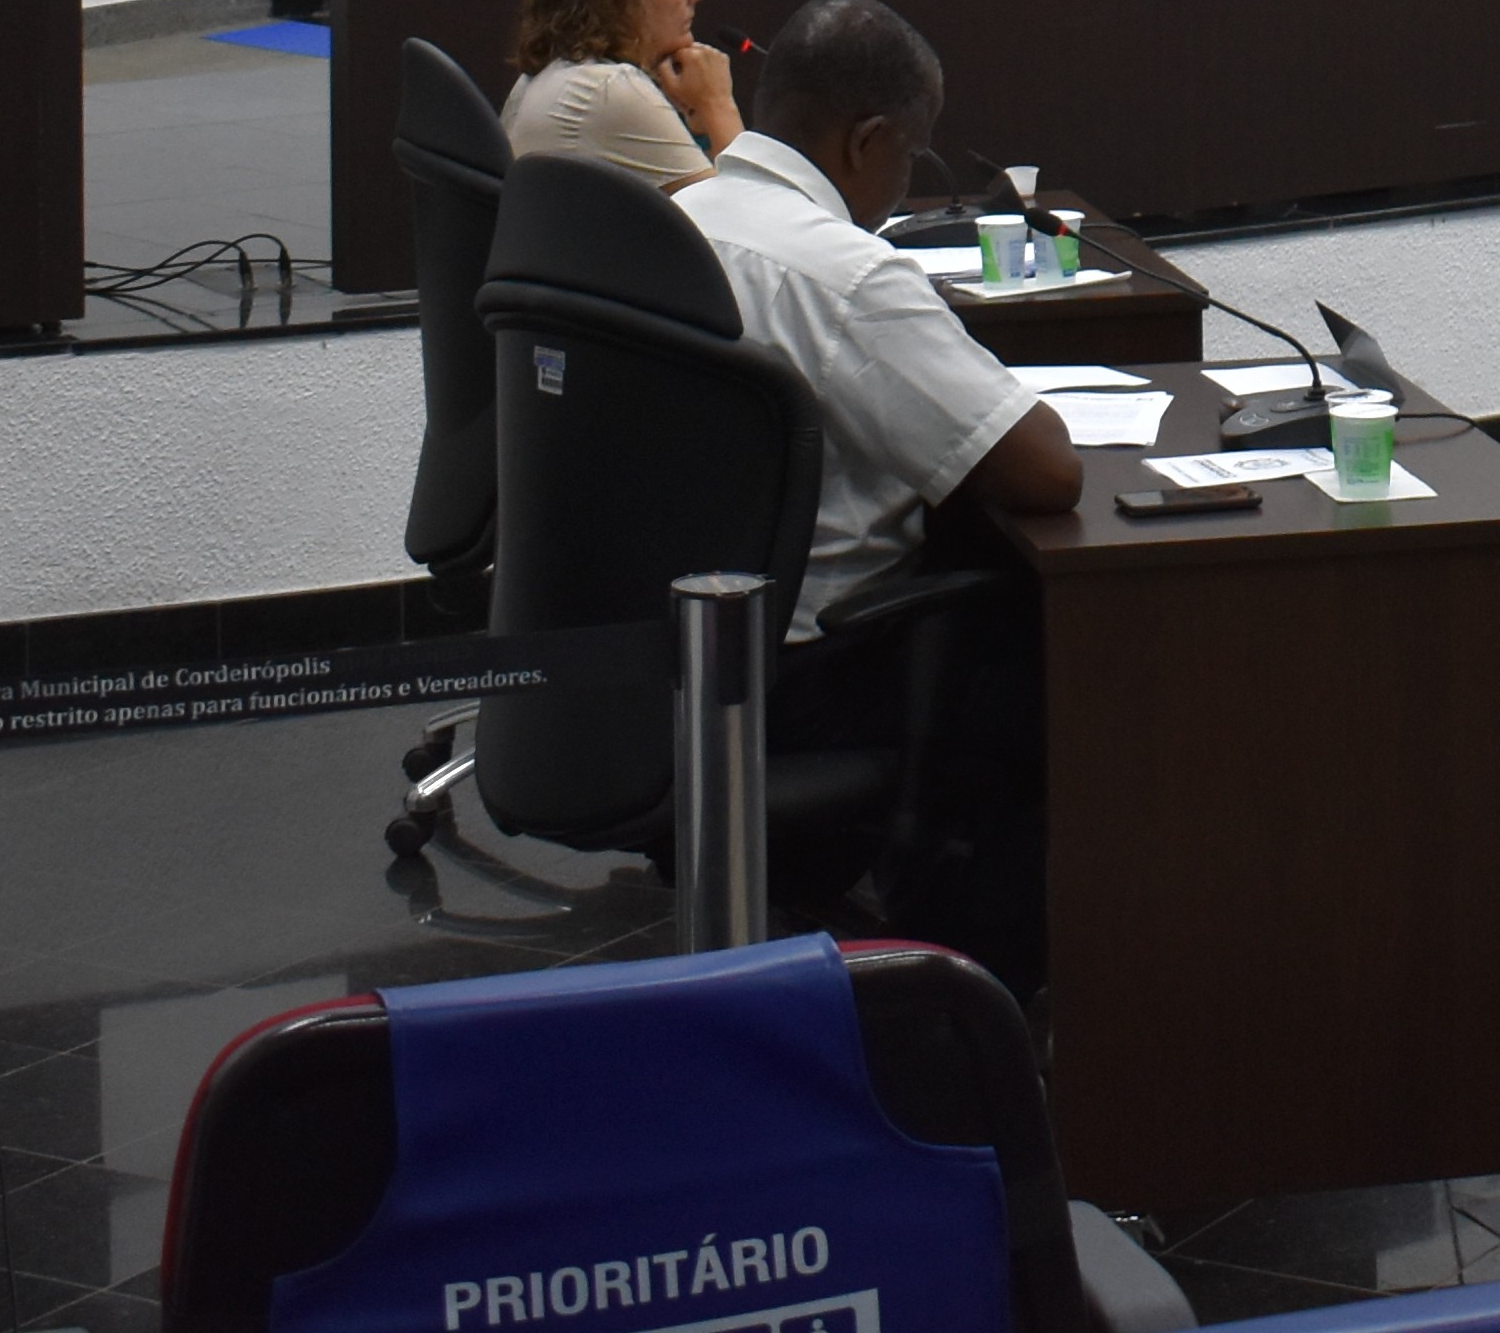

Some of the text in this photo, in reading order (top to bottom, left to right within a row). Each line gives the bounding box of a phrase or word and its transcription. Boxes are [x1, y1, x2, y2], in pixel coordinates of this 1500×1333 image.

[9, 705, 99, 730] restrito
[104, 702, 186, 728] apenas
[190, 695, 245, 721] para
[249, 680, 393, 713] funcionários
[397, 684, 411, 698] e
[417, 669, 548, 695] Vereadores.
[20, 672, 137, 703] Municipal
[140, 669, 170, 690] de
[174, 656, 332, 689] Cordeirópolis
[443, 1225, 829, 1331] PRIORITÁRIO
